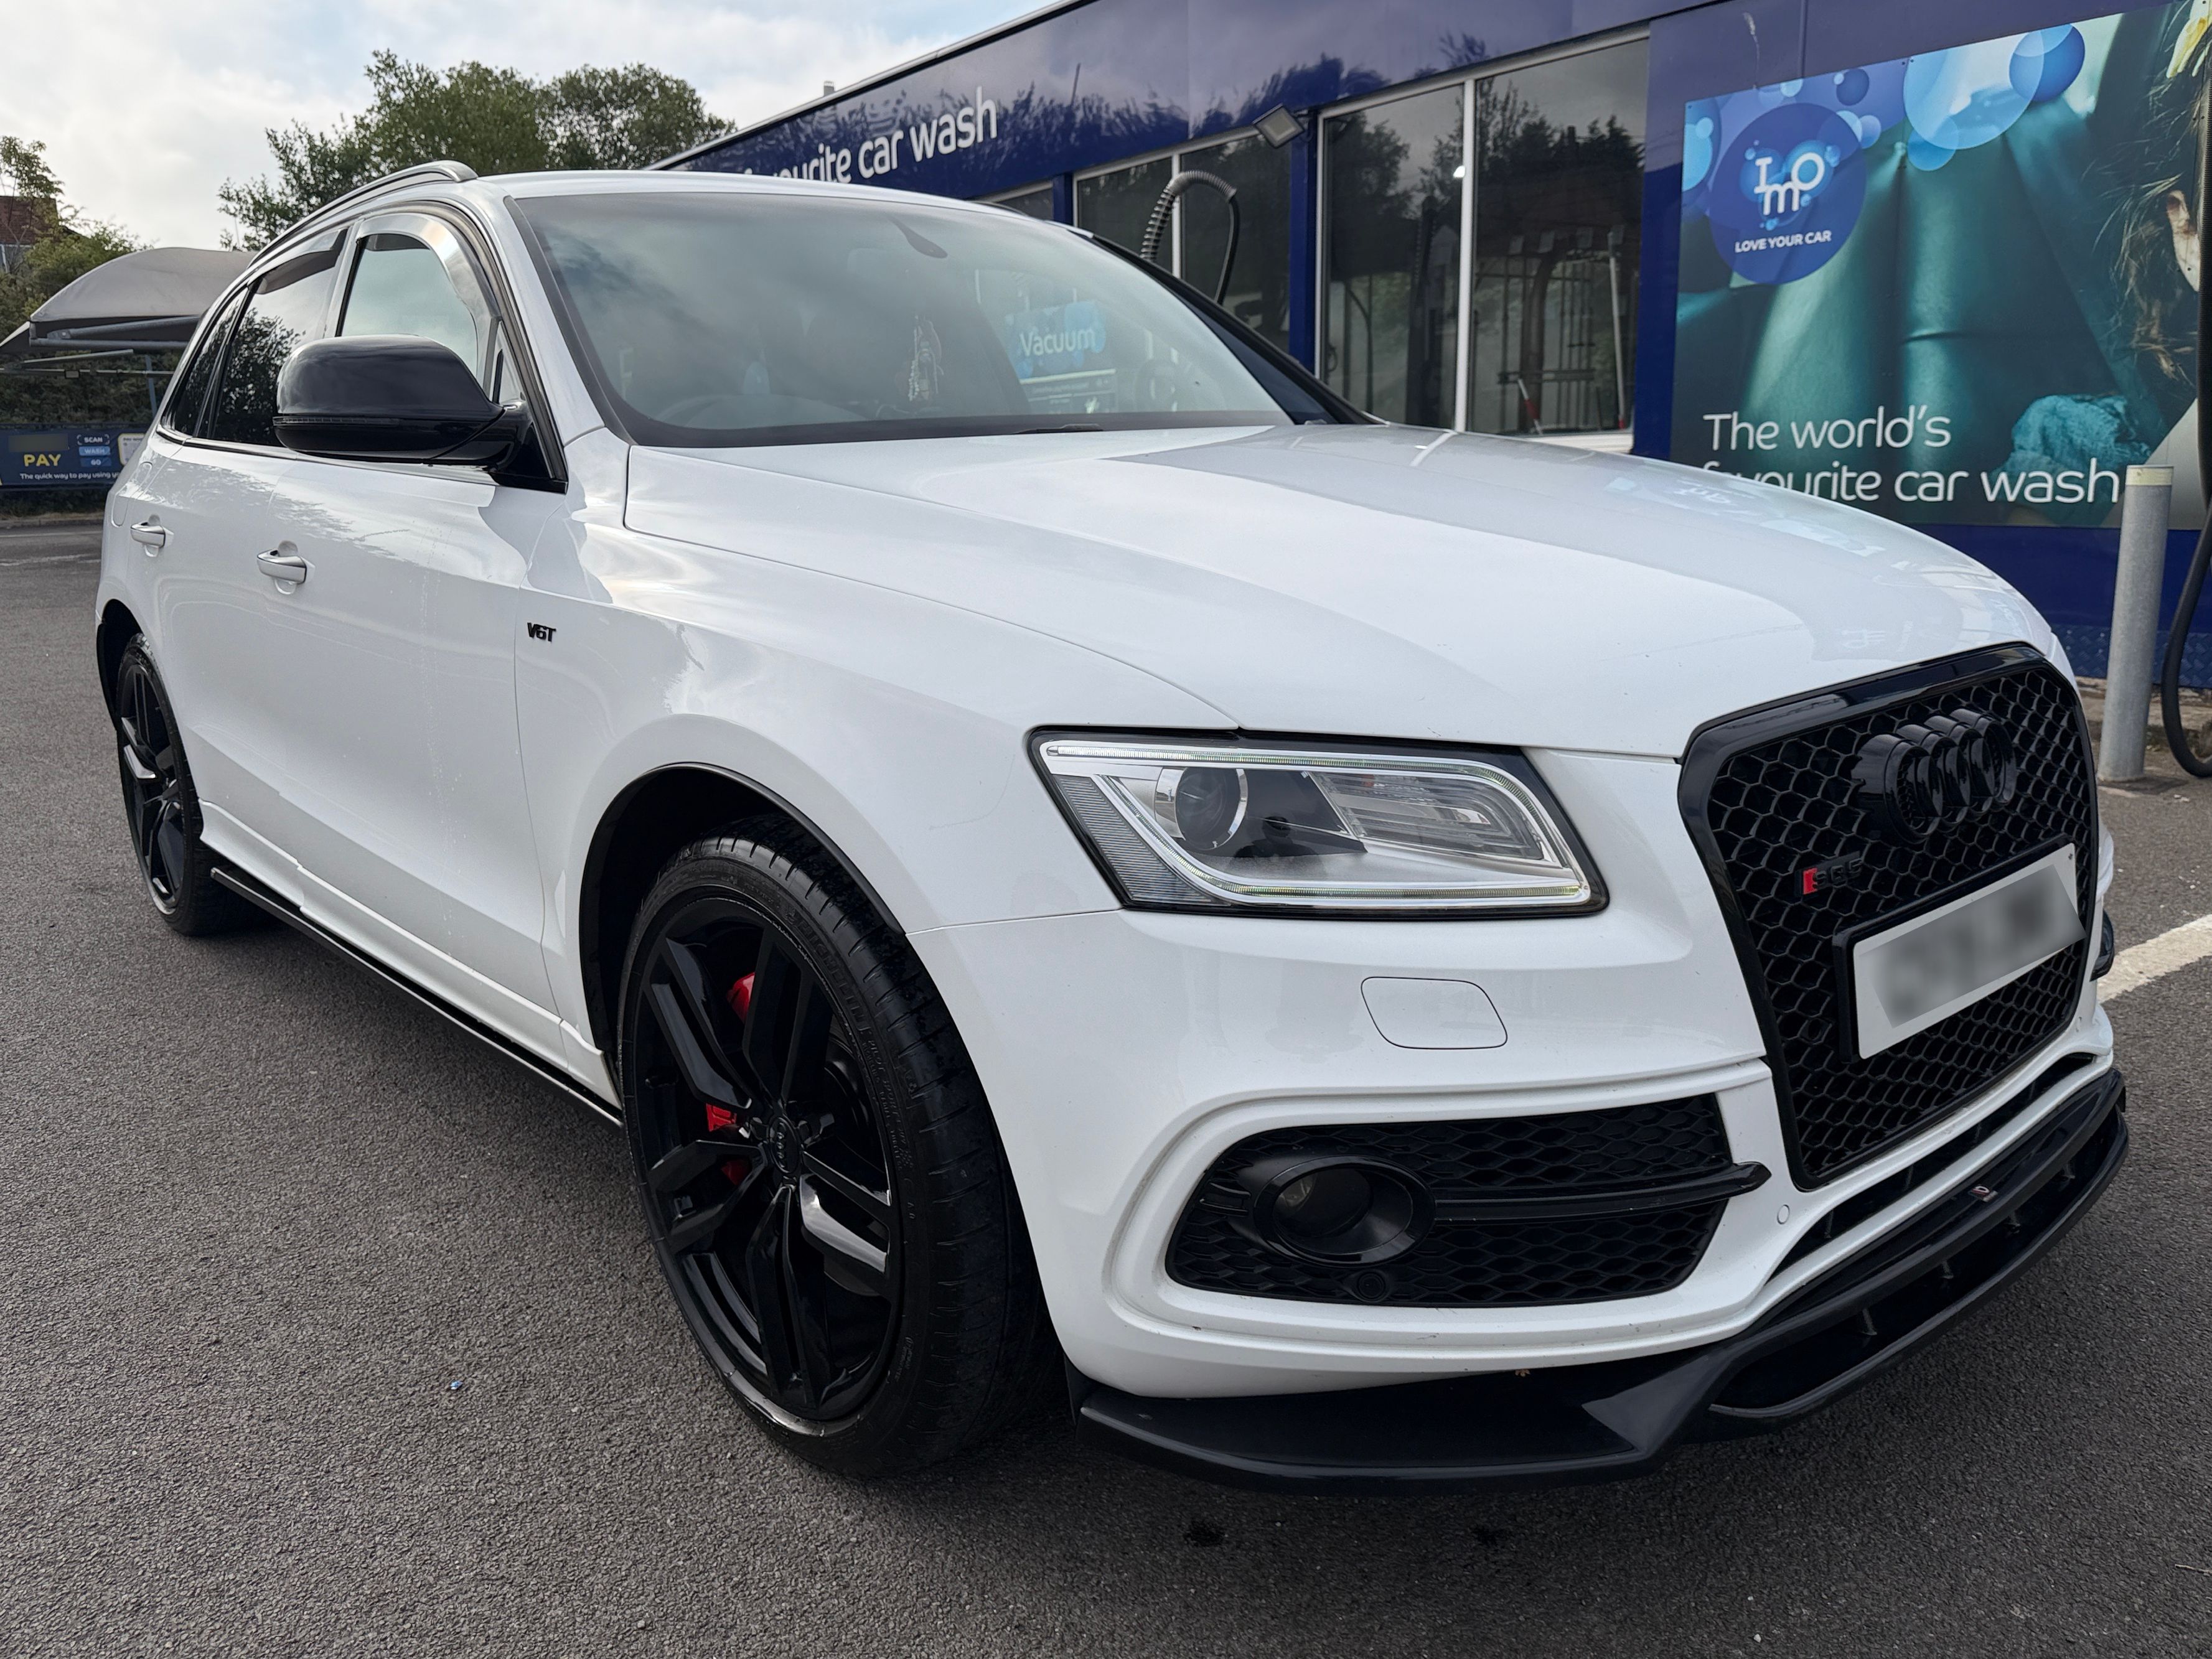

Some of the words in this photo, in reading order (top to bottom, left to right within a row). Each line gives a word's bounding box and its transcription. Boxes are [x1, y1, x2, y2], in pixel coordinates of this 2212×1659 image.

[745, 143, 851, 184] urite
[858, 130, 904, 178] car
[909, 86, 997, 162] wash
[1735, 238, 1767, 253] LOVE
[1768, 233, 1804, 248] YOUR
[1805, 230, 1832, 245] CAR
[1019, 329, 1096, 357] Vacuum
[1703, 411, 1779, 451] The
[1791, 404, 1951, 449] world's
[24, 454, 61, 467] PAY
[35, 472, 53, 480] quick
[93, 472, 111, 480] using
[1894, 471, 1969, 502] car
[1980, 457, 2119, 503] wash
[527, 622, 556, 642] V6T
